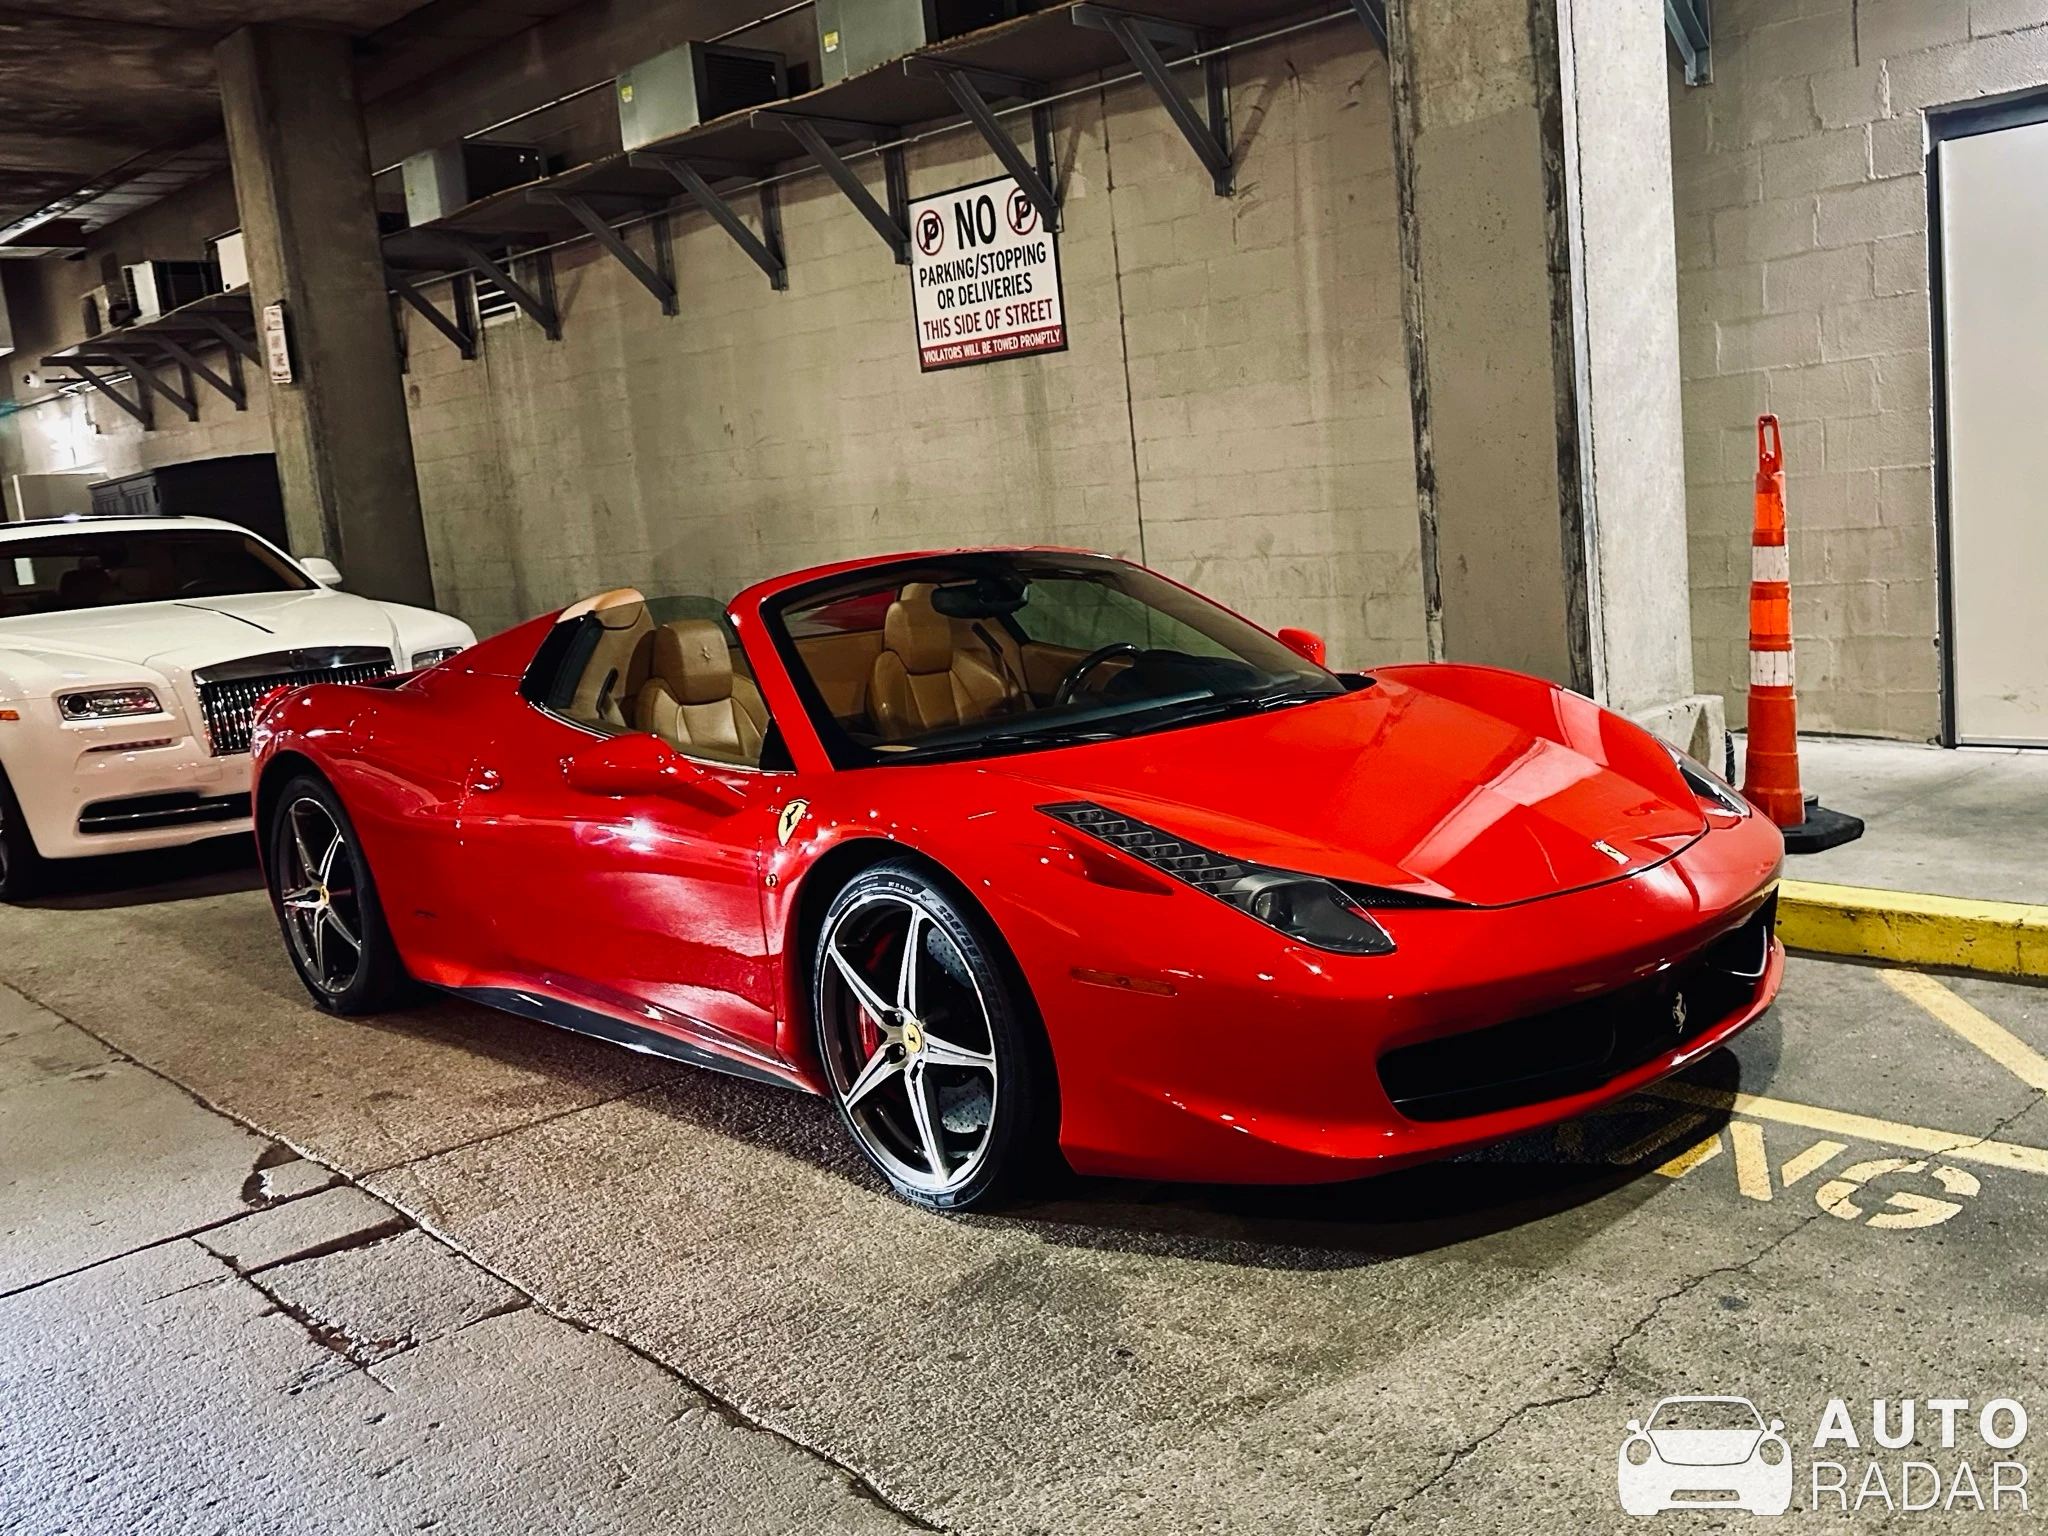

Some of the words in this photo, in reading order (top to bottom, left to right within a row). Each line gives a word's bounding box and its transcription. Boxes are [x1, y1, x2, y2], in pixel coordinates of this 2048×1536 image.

[954, 194, 997, 250] NO
[919, 241, 1046, 288] PARKING/STOPPING
[937, 287, 955, 310] OR
[959, 272, 1033, 306] DELIVERIES
[923, 317, 951, 340] THIS
[954, 311, 982, 336] SIDE
[985, 308, 1001, 330] OF
[1005, 298, 1053, 327] STREET
[923, 345, 963, 363] VIOLATORS
[963, 342, 980, 357] WILL
[981, 341, 992, 354] BE
[993, 335, 1019, 352] TOWED
[1020, 329, 1061, 347] PROMPTLY
